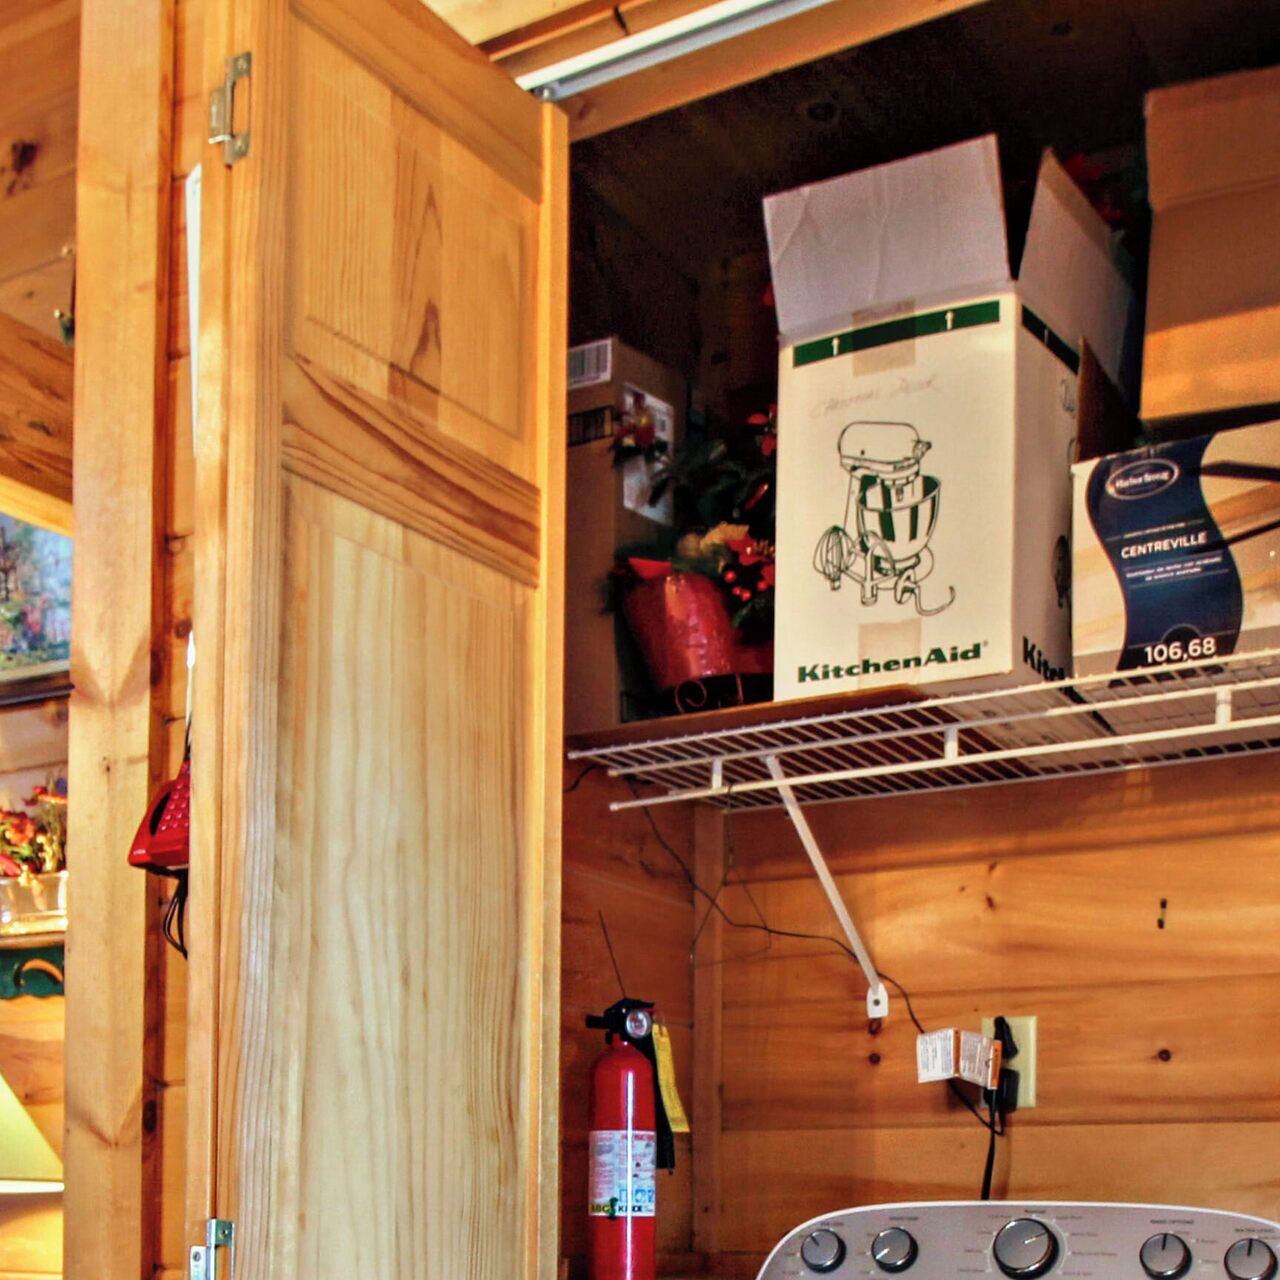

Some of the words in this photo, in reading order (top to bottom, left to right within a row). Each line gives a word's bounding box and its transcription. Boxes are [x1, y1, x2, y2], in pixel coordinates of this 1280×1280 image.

[1120, 531, 1208, 560] CENTREVILLE
[797, 641, 982, 683] KitchenAid
[1143, 637, 1216, 664] 106,68
